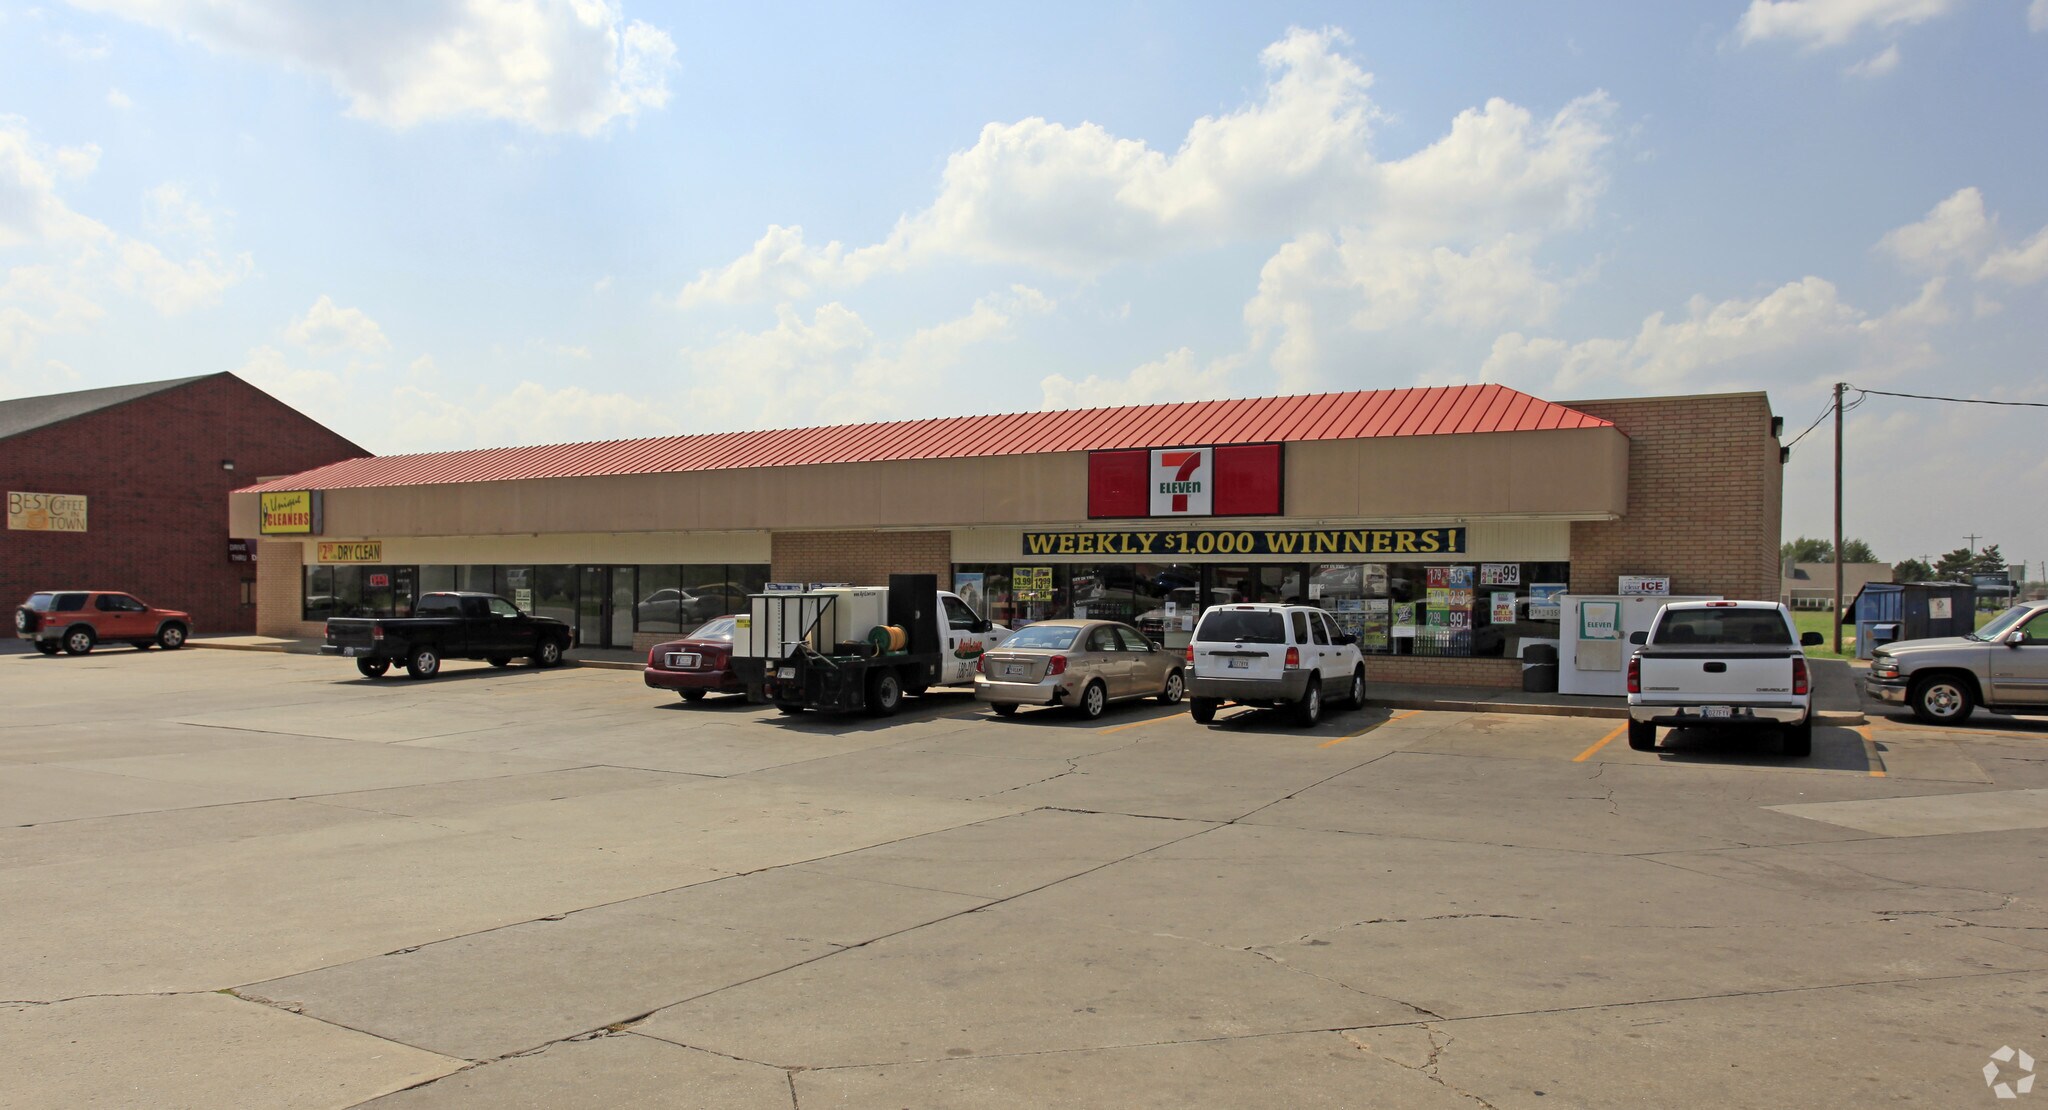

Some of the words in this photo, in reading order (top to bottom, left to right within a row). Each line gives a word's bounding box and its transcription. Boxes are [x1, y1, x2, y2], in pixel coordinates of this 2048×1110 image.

[1162, 451, 1201, 512] 7
[48, 516, 85, 530] TOWN
[267, 513, 309, 526] CLEANERS
[229, 543, 247, 551] DRIVE
[1027, 533, 1158, 554] WEEKLY
[1164, 531, 1256, 554] $1,000
[231, 554, 248, 562] THRU
[337, 544, 354, 560] DRY
[354, 544, 380, 560] CLEAN
[1641, 581, 1664, 591] ICE
